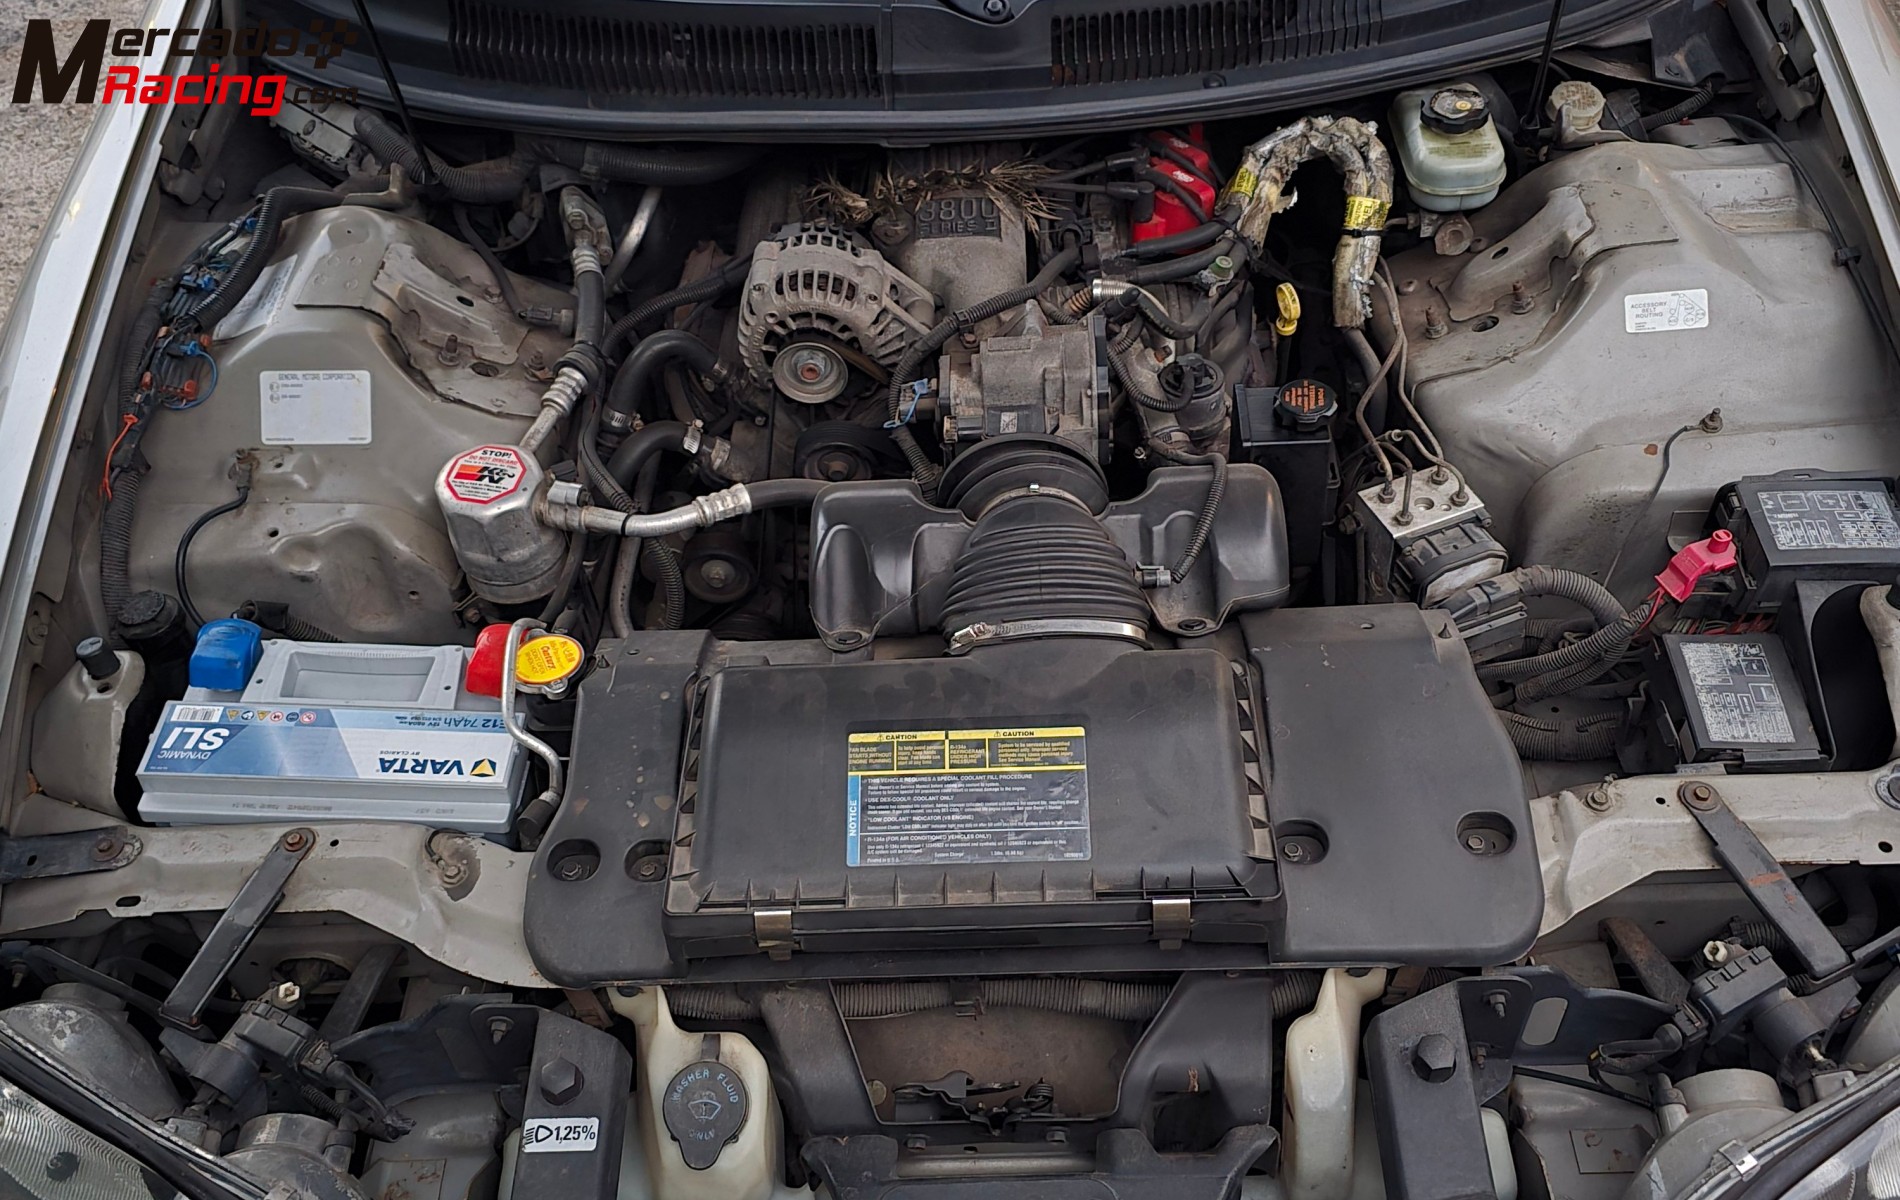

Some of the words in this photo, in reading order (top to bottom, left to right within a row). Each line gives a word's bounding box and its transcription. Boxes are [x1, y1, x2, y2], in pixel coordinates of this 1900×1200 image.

[920, 199, 998, 221] 3800
[1631, 301, 1667, 309] ACCESSORY
[481, 450, 512, 458] STOP!
[444, 717, 478, 728] 74Ah
[161, 727, 230, 750] SLI
[157, 750, 212, 760] DYNAMIC
[378, 757, 464, 775] VARTA
[849, 799, 857, 837] NOTICE
[671, 1068, 710, 1103] WASHER
[716, 1072, 739, 1103] FLUID
[554, 1125, 596, 1144] 1,25%
